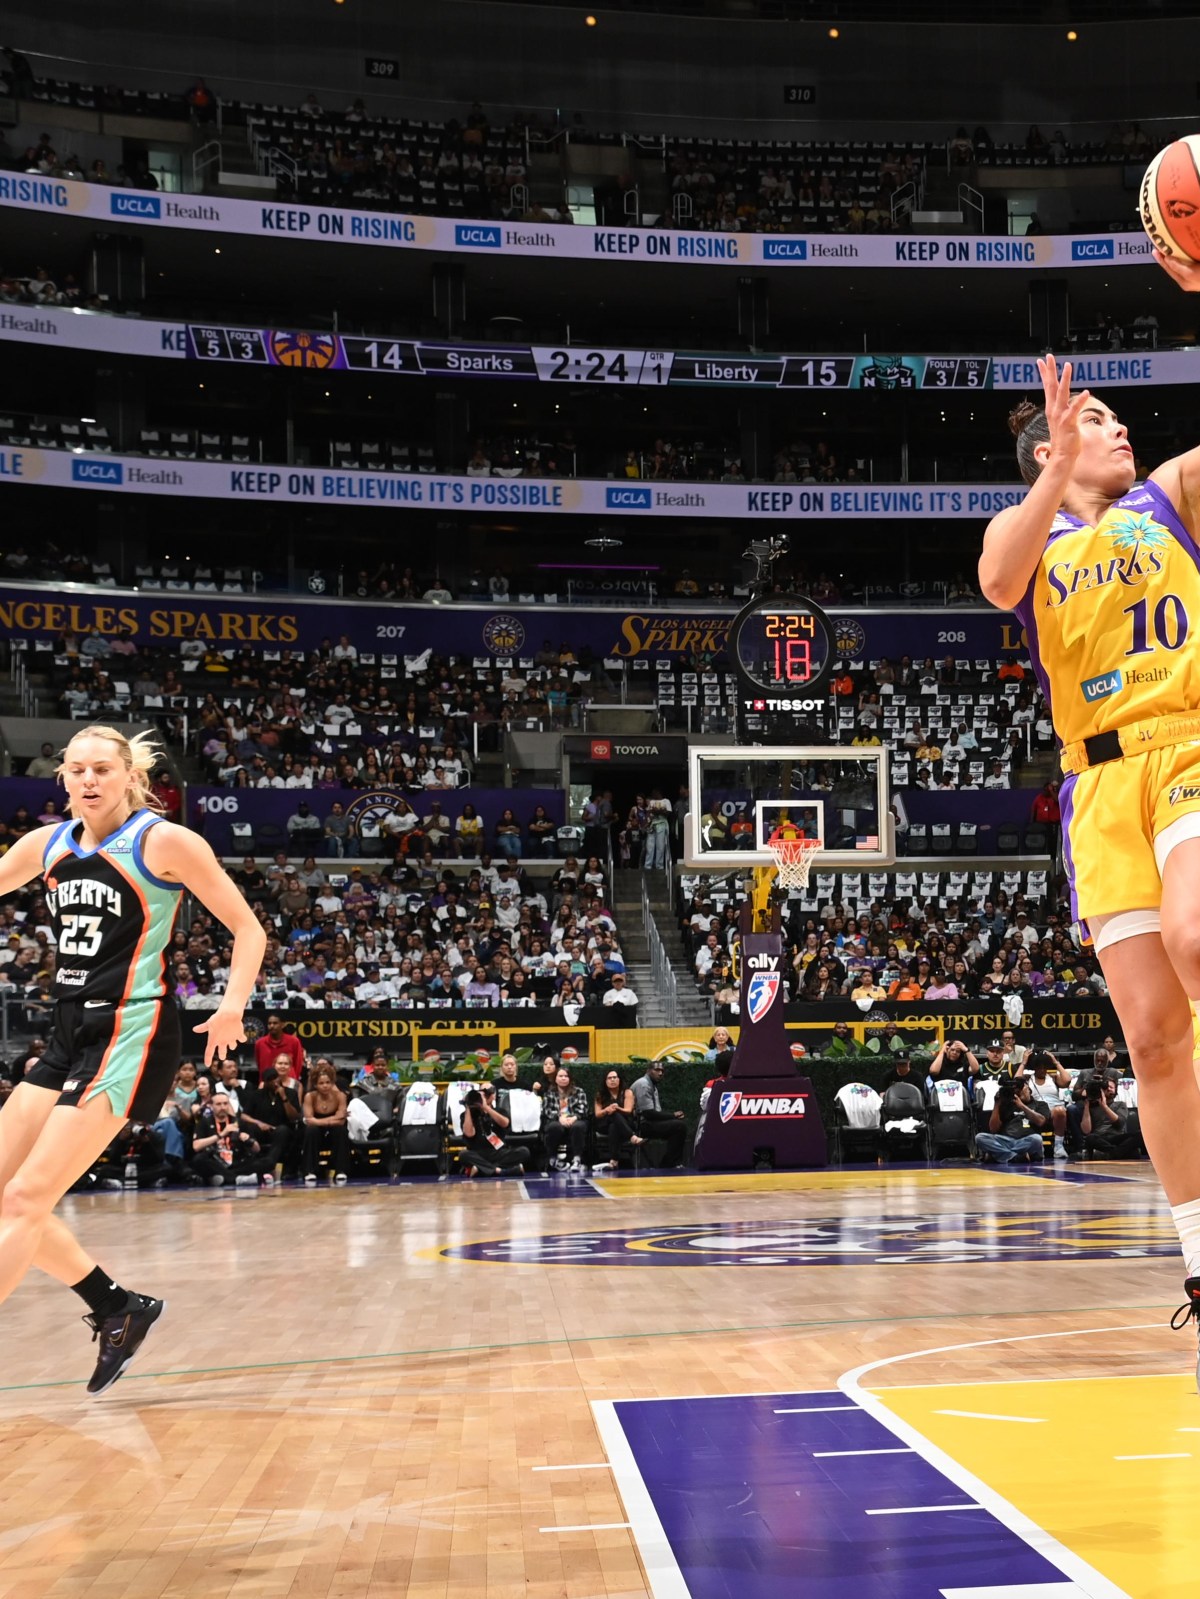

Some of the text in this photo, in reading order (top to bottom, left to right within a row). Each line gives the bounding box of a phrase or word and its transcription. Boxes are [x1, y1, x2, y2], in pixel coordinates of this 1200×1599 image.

[371, 62, 394, 75] 309
[789, 89, 810, 101] 310
[117, 199, 220, 221] UCLA Health
[262, 209, 415, 241] KEEP ON RISING
[461, 230, 555, 247] UCLA Health
[595, 233, 737, 258] KEEP ON RISING
[769, 244, 858, 258] UCLA Health
[896, 242, 1034, 261] KEEP ON RISING
[1077, 242, 1153, 256] UCLA Healt
[1, 315, 57, 335] Health
[162, 330, 185, 350] KE
[201, 330, 258, 342] TOL FOULS
[207, 341, 253, 358] 5 3
[365, 343, 402, 369] 14
[650, 352, 664, 360] QTR
[447, 353, 513, 371] Sparks
[550, 351, 628, 381] 2:24
[930, 361, 979, 370] FOULS TOL
[653, 364, 661, 384] 1
[695, 362, 758, 382] Liberty
[802, 361, 837, 387] 15
[936, 371, 978, 386] 3 5
[993, 364, 1042, 383] EVER
[78, 466, 183, 485] UCLA Health
[231, 471, 562, 506] KEEP ON BELIEVING IT'S POSSIBLE
[612, 493, 705, 507] UCLA Health
[748, 492, 792, 511] KEEP
[800, 492, 823, 512] ON
[831, 492, 923, 512] BELIEVING
[930, 492, 962, 512] IT'S
[150, 611, 298, 642] SPARKS
[376, 626, 406, 638] 207
[652, 619, 677, 629] LOS
[766, 616, 814, 637] 2:24
[1124, 594, 1189, 656] 10
[938, 631, 966, 643] 208
[775, 640, 810, 680] 18
[1087, 668, 1172, 696] UCLA Health
[764, 700, 824, 710] TISSOT
[614, 746, 658, 754] TOYOTA
[198, 796, 238, 813] 106
[46, 879, 121, 917] LIBERTY
[59, 915, 103, 956] 23
[748, 953, 779, 971] ally
[1041, 1013, 1101, 1029] CLUB
[741, 1098, 805, 1114] WNBA
